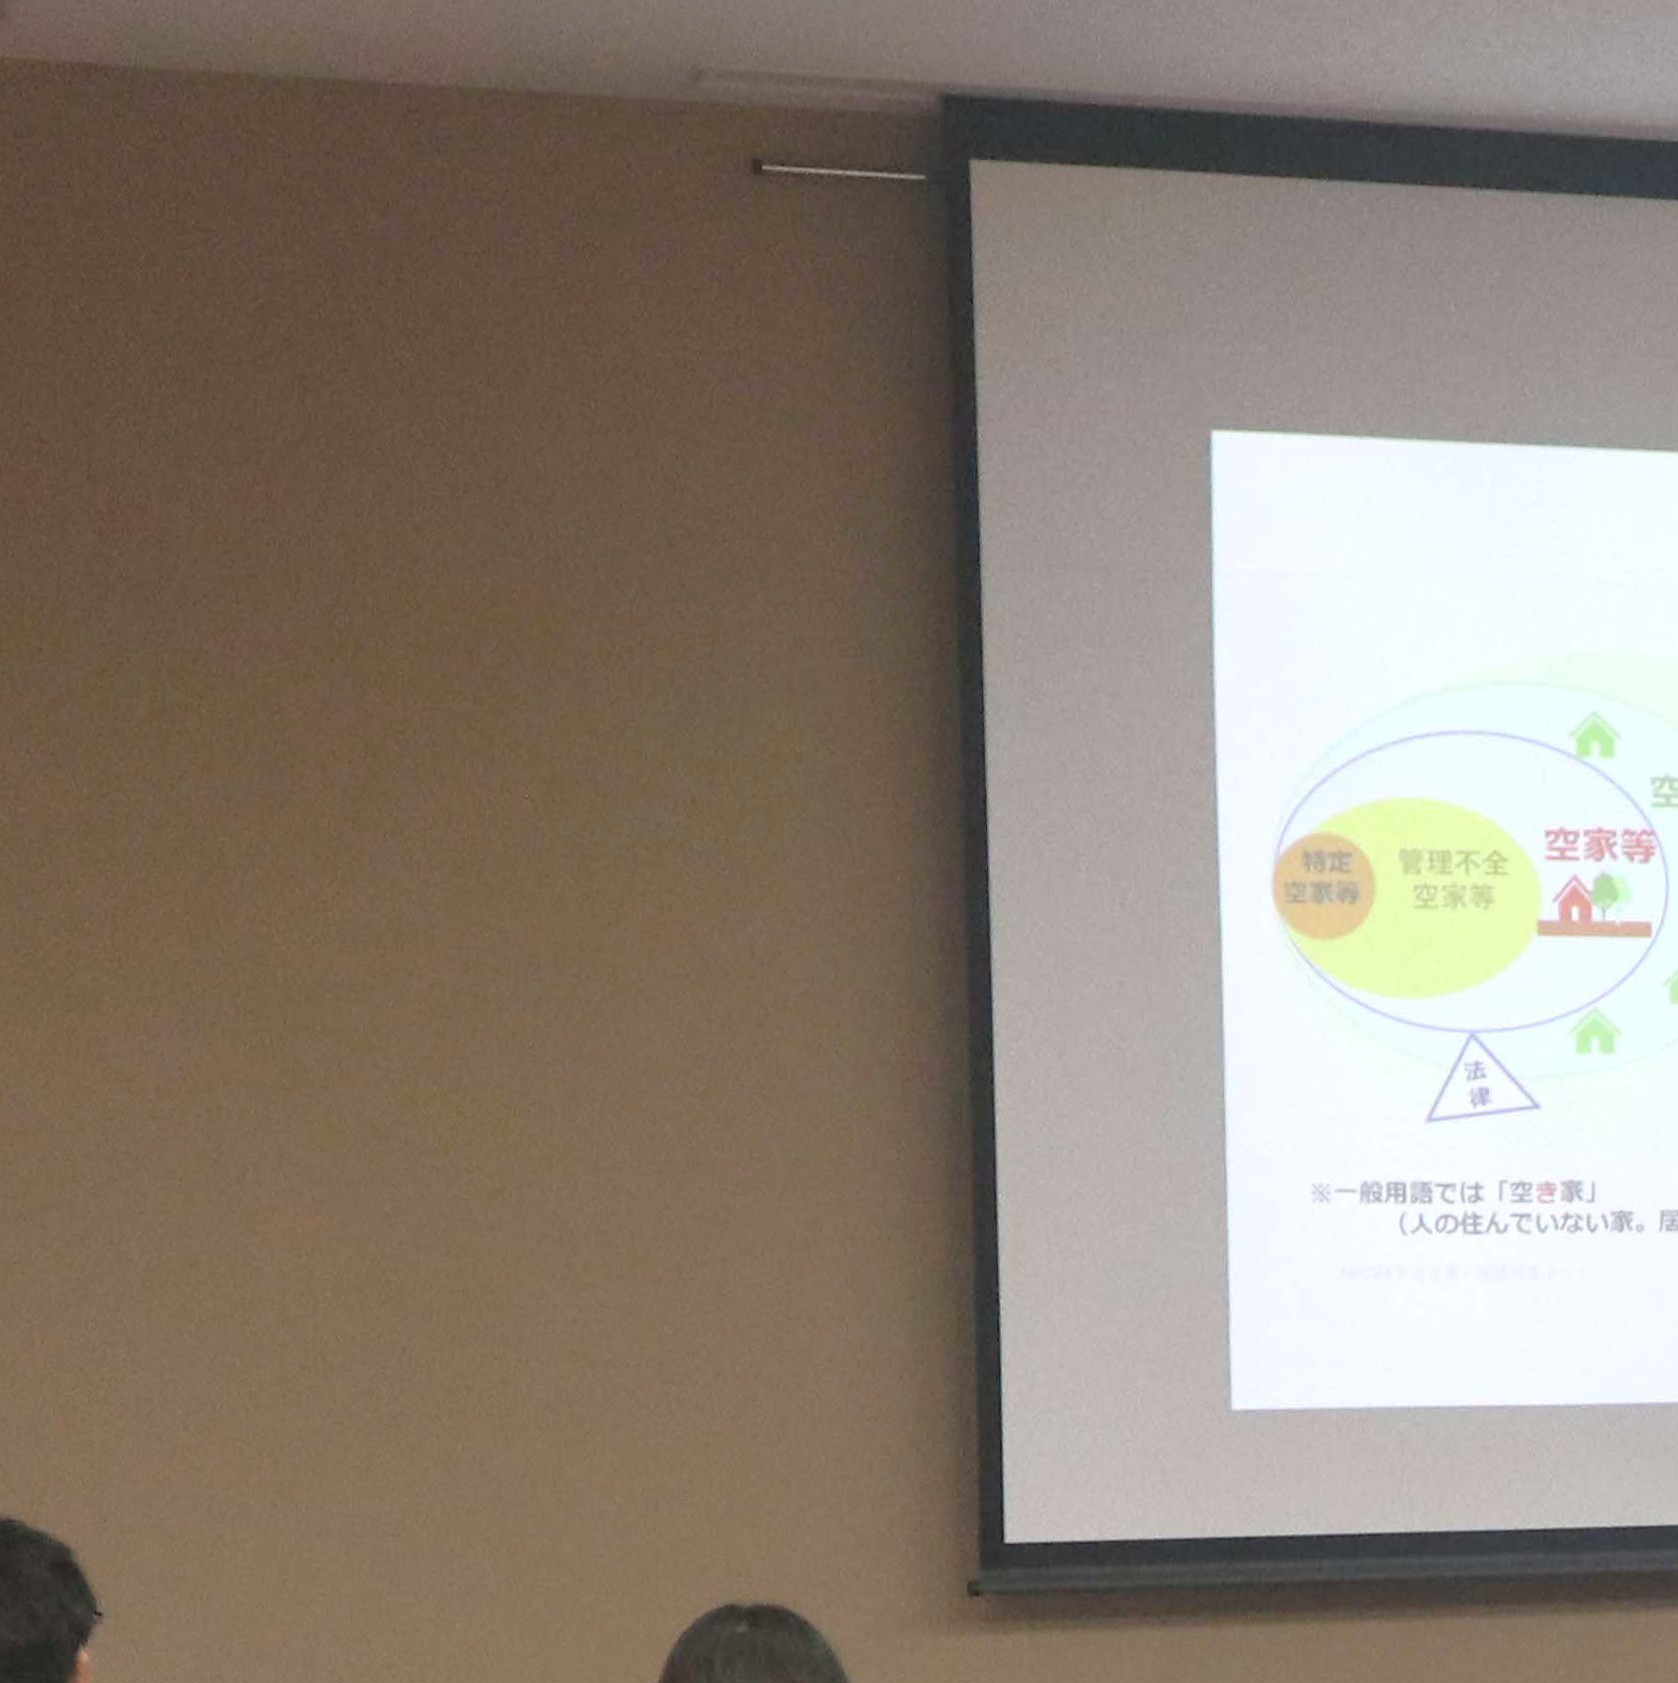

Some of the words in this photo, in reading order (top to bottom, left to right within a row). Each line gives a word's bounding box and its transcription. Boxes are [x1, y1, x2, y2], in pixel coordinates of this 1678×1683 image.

[1544, 827, 1657, 864] 空家等
[1302, 848, 1353, 874] 特定
[1398, 848, 1510, 877] 管理不全
[1282, 879, 1361, 906] 空家等
[1412, 883, 1495, 911] 空家等
